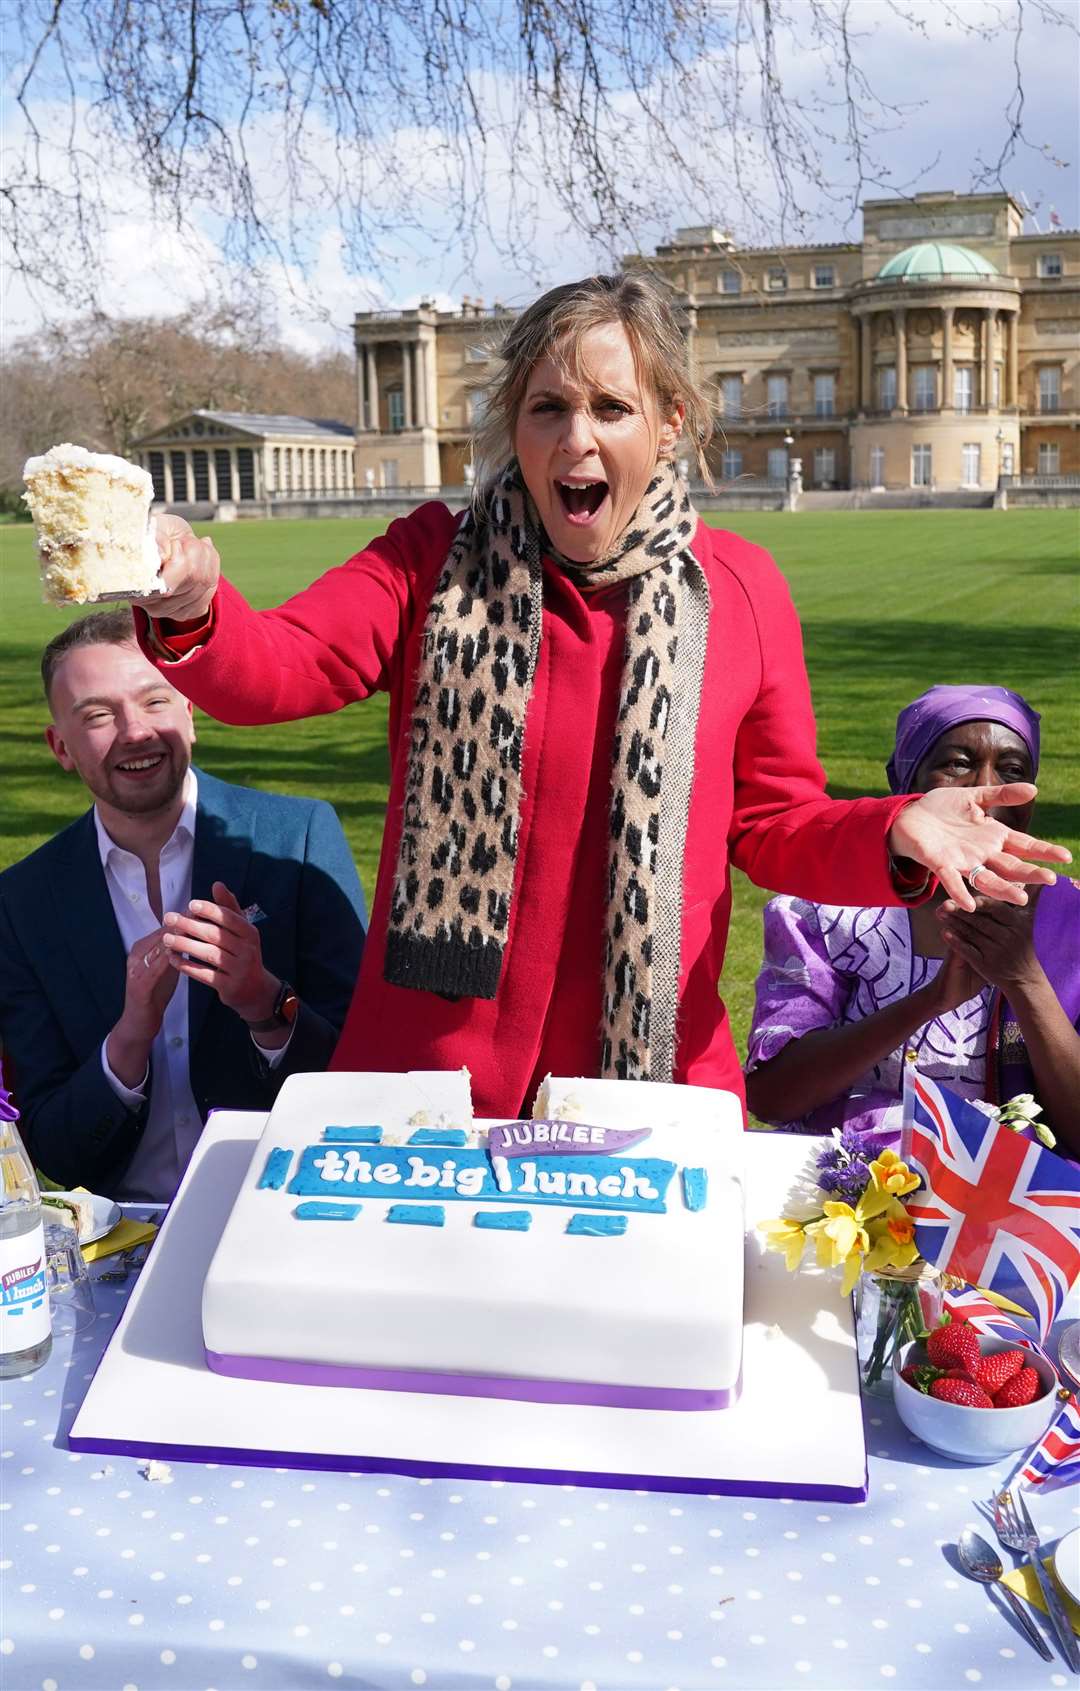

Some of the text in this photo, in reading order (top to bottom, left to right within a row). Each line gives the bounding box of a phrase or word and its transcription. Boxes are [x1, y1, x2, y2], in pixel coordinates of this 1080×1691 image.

[500, 1123, 606, 1146] JUBILEE
[312, 1150, 658, 1200] the big lunch
[5, 1266, 36, 1286] JUBILEE
[13, 1278, 44, 1300] lunch
